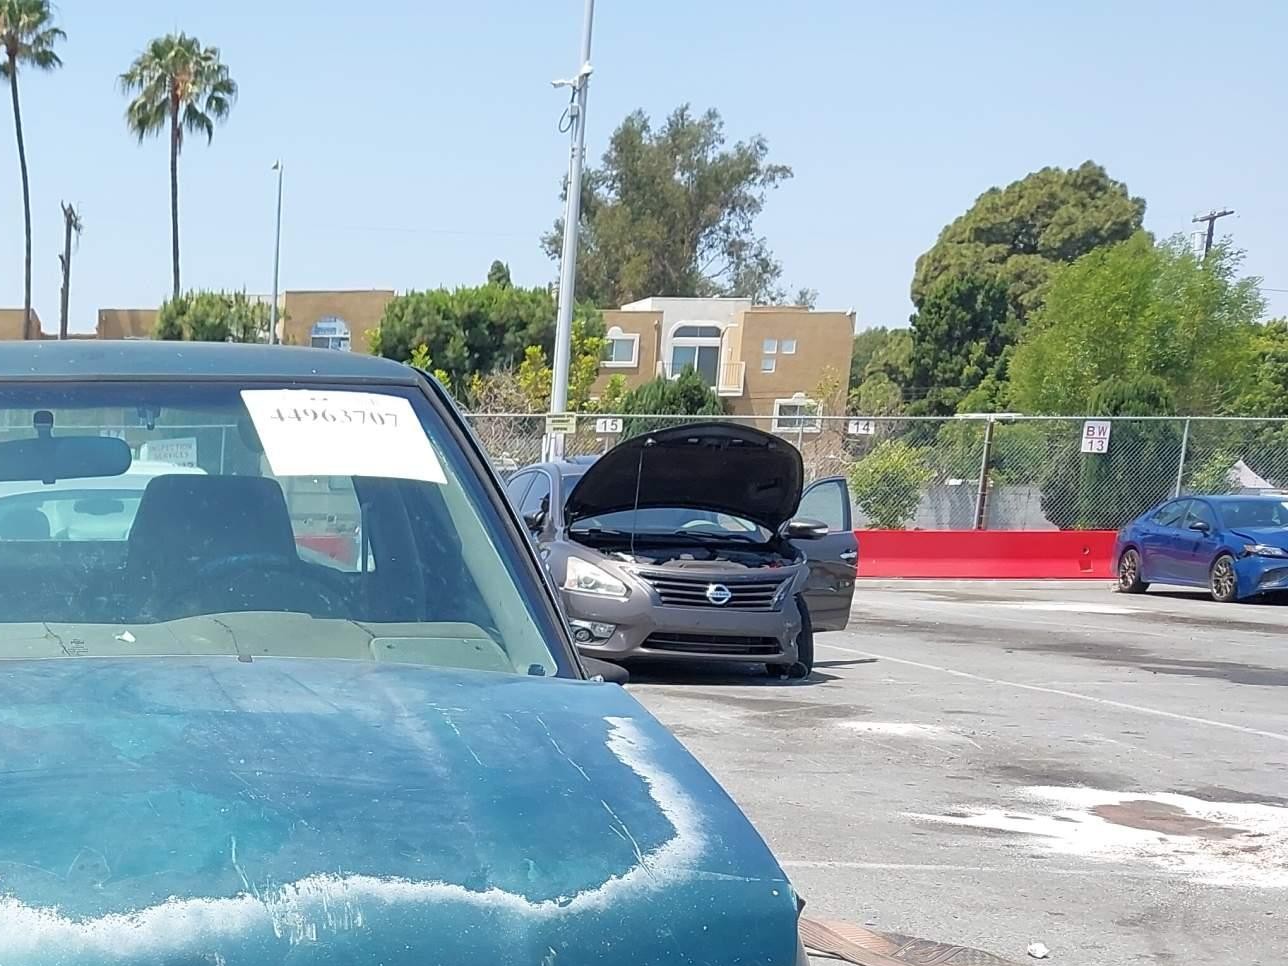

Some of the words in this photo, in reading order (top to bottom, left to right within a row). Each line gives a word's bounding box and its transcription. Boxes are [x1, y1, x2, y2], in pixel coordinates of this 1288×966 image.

[270, 408, 398, 427] 44963707
[601, 420, 618, 431] 15
[853, 421, 870, 432] 14
[1087, 425, 1107, 436] BW
[1088, 440, 1104, 451] 13
